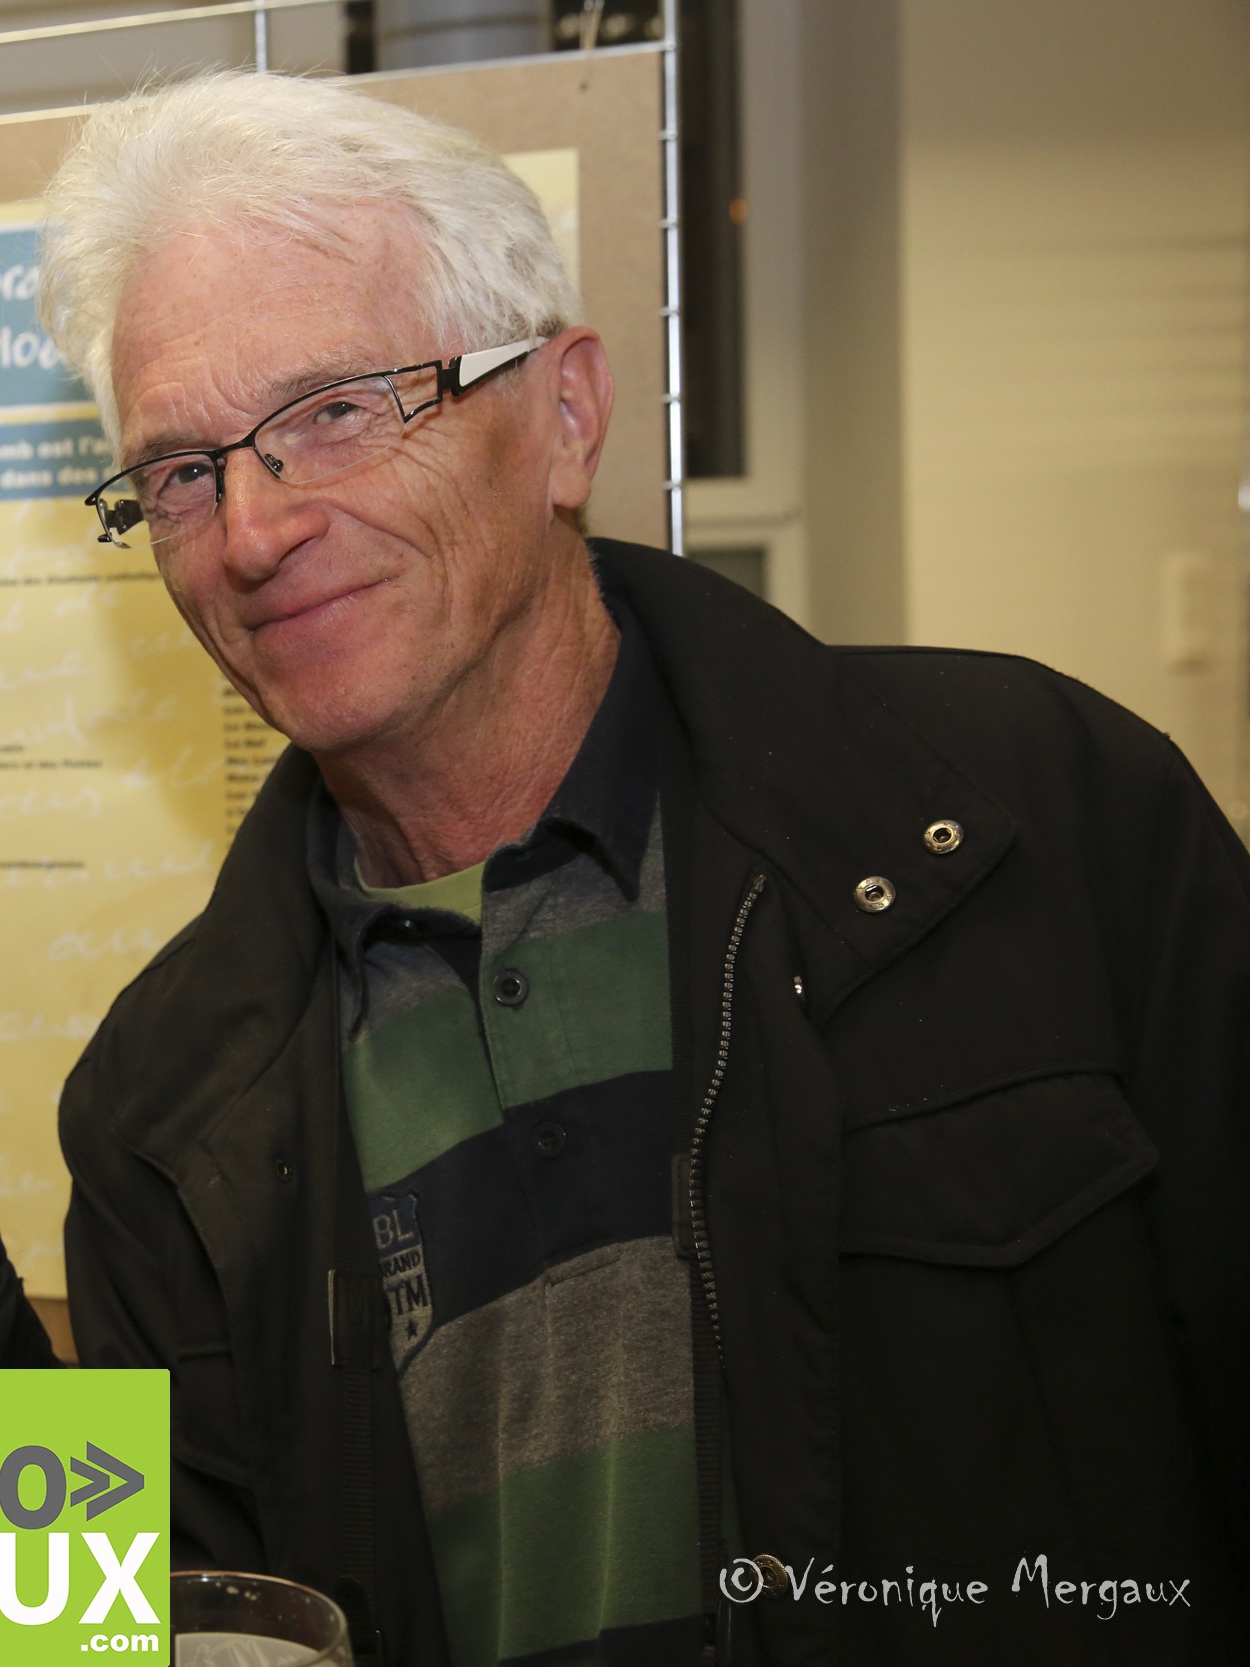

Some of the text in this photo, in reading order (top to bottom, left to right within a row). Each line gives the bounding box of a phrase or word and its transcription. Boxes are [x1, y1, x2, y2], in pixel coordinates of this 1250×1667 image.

[37, 438, 74, 459] est
[0, 468, 53, 490] dans
[58, 465, 98, 487] des
